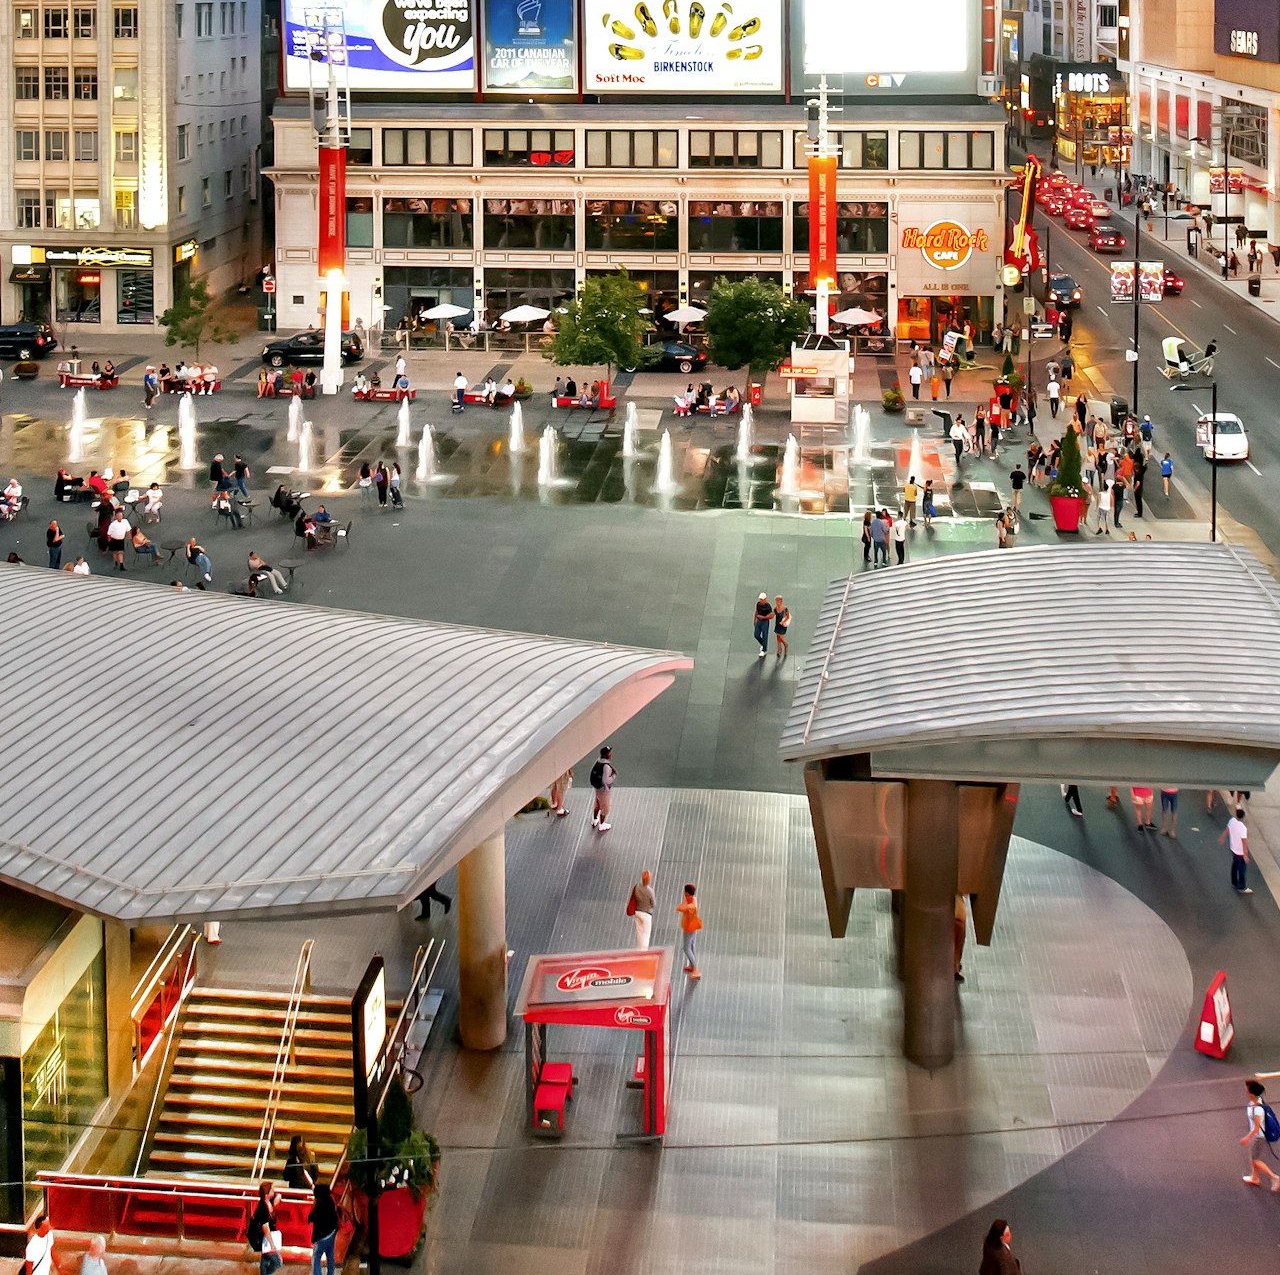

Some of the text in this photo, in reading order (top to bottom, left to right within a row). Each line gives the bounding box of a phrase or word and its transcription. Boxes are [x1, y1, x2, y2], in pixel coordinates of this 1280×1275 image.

[404, 9, 468, 22] expecting
[404, 21, 460, 65] you
[1076, 22, 1085, 59] FITNESS
[1231, 29, 1258, 55] SEARS
[495, 48, 565, 59] 2011 CANADIAN
[490, 59, 510, 69] CAR
[511, 59, 523, 68] OF
[654, 61, 714, 72] BIRKENSTOCK
[596, 74, 646, 83] Soft Moc
[1069, 72, 1110, 92] ROOTS
[902, 228, 989, 252] Hard Rock
[933, 251, 959, 261] CAFE
[563, 970, 628, 988] Virgin mobile
